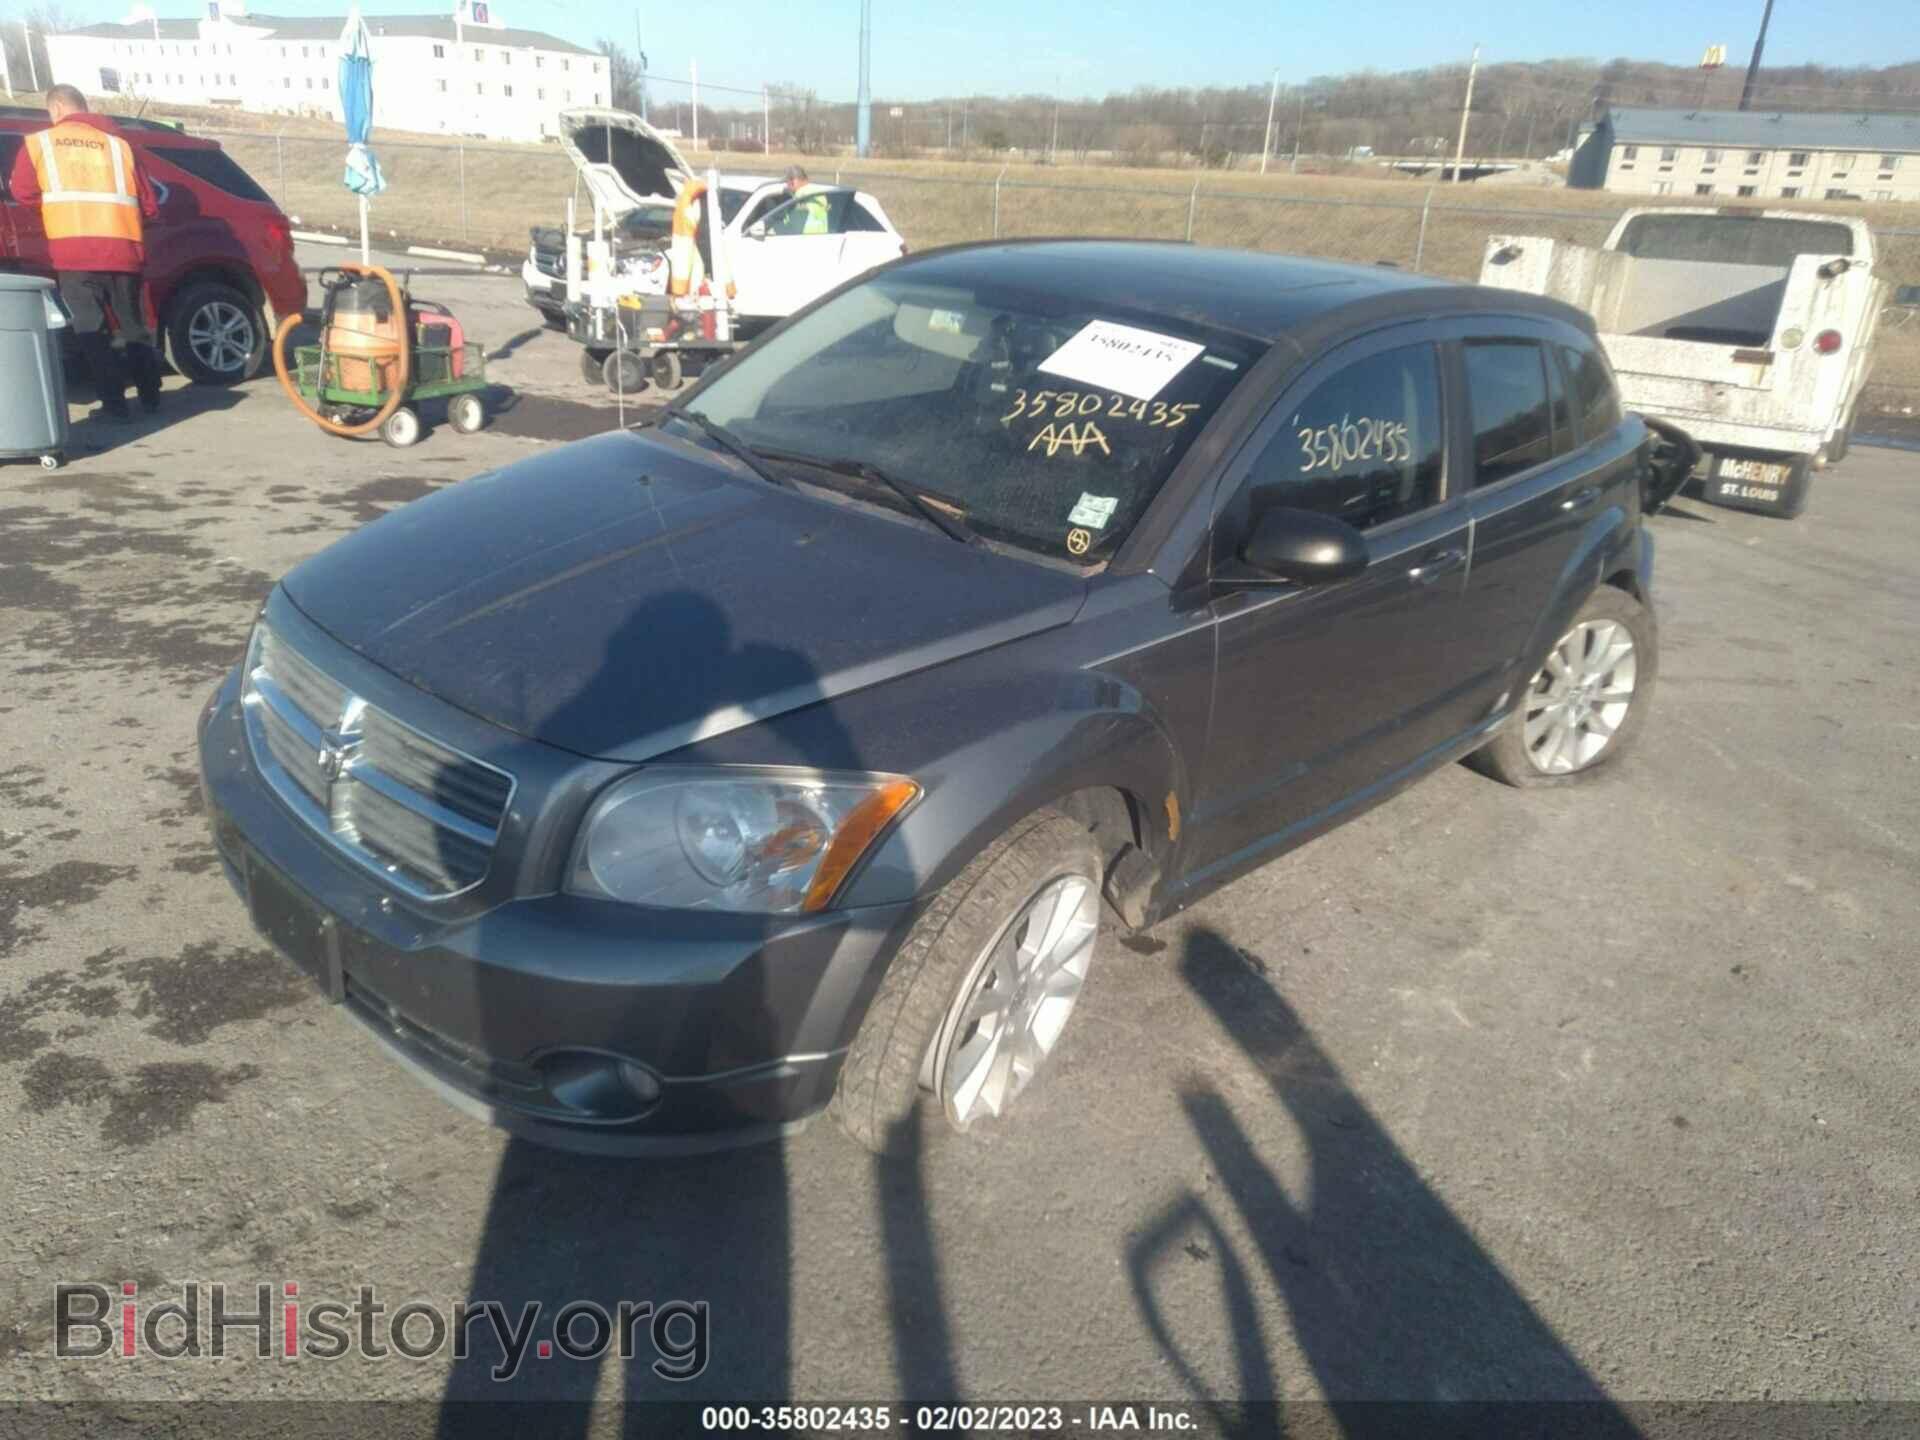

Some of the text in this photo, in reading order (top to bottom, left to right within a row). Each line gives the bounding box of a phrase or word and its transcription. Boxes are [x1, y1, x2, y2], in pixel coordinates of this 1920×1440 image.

[55, 138, 105, 151] AGENCY
[1000, 387, 1201, 428] 35802435
[1027, 421, 1111, 457] AAA
[1298, 417, 1411, 471] 35802435
[1718, 458, 1792, 484] McHENRY
[1721, 483, 1778, 501] ST. LOUIS
